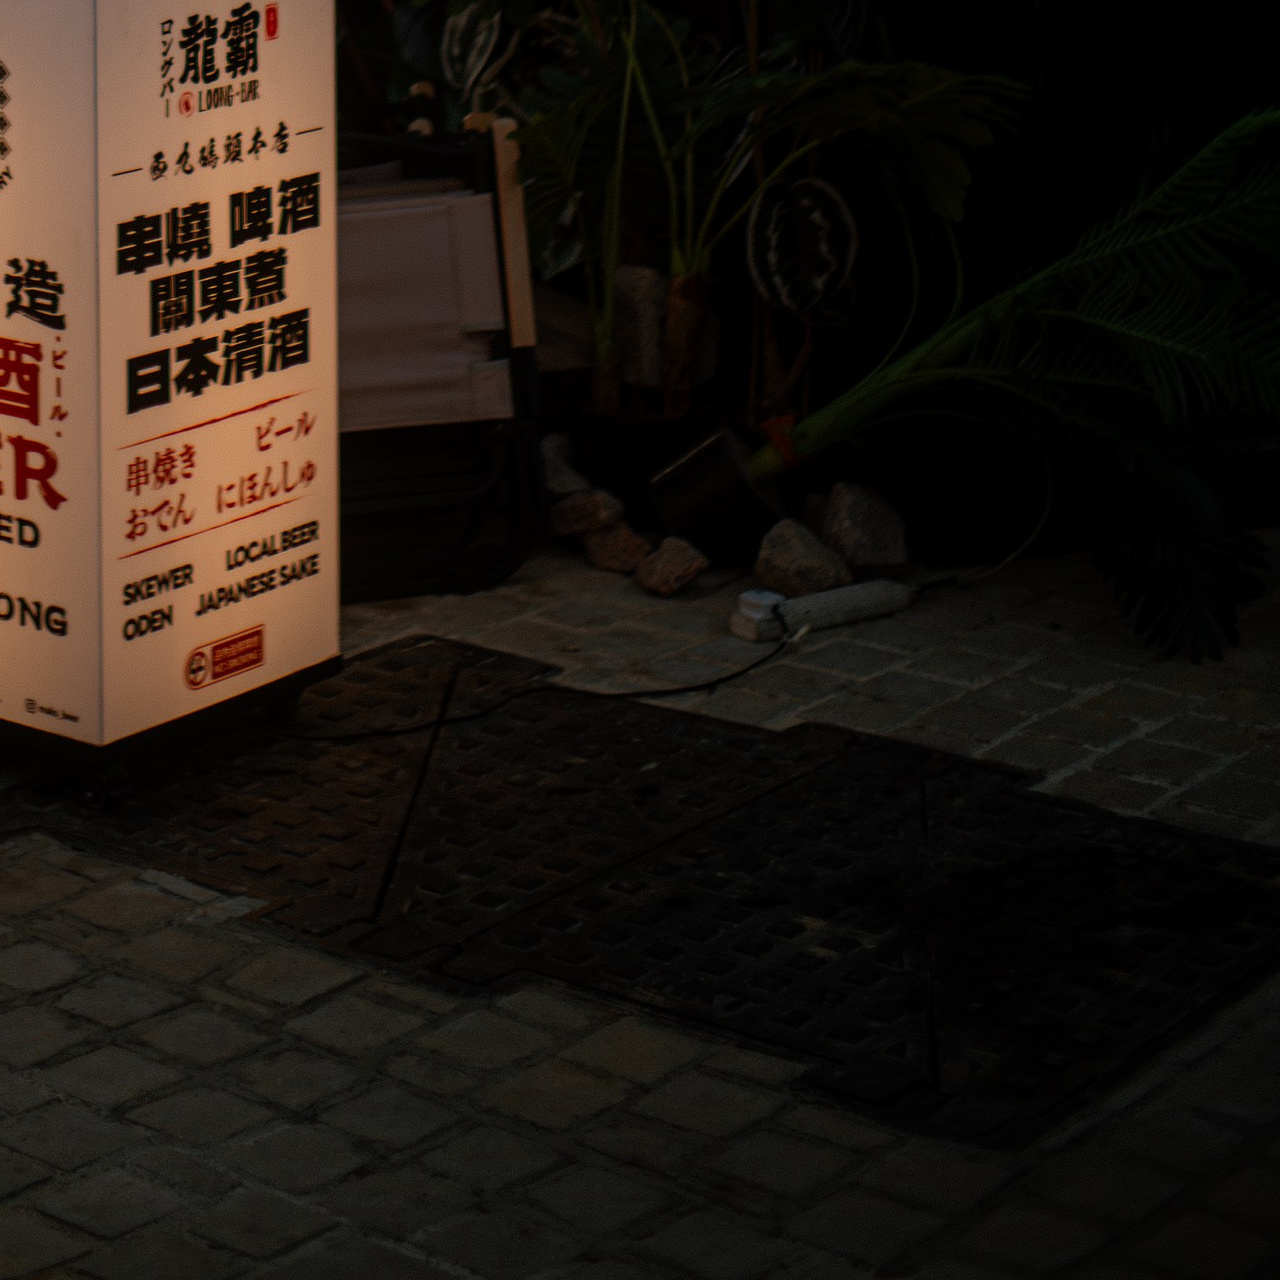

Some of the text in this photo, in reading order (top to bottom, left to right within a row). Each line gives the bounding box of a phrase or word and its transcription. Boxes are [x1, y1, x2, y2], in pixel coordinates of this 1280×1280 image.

[179, 2, 260, 84] 龍霸
[116, 171, 320, 275] 串燒 啤酒
[149, 246, 289, 337] 關東煮
[126, 307, 310, 415] 日本清酒
[256, 411, 317, 452] ビール
[127, 443, 197, 496] 串焼き
[216, 460, 317, 514] にほんしゅ
[125, 493, 197, 541] おでん
[225, 520, 320, 572] LOCAL BEER
[123, 563, 194, 607] SKEWER
[195, 553, 320, 616] JAPANESE SAKE
[123, 605, 173, 641] ODEN
